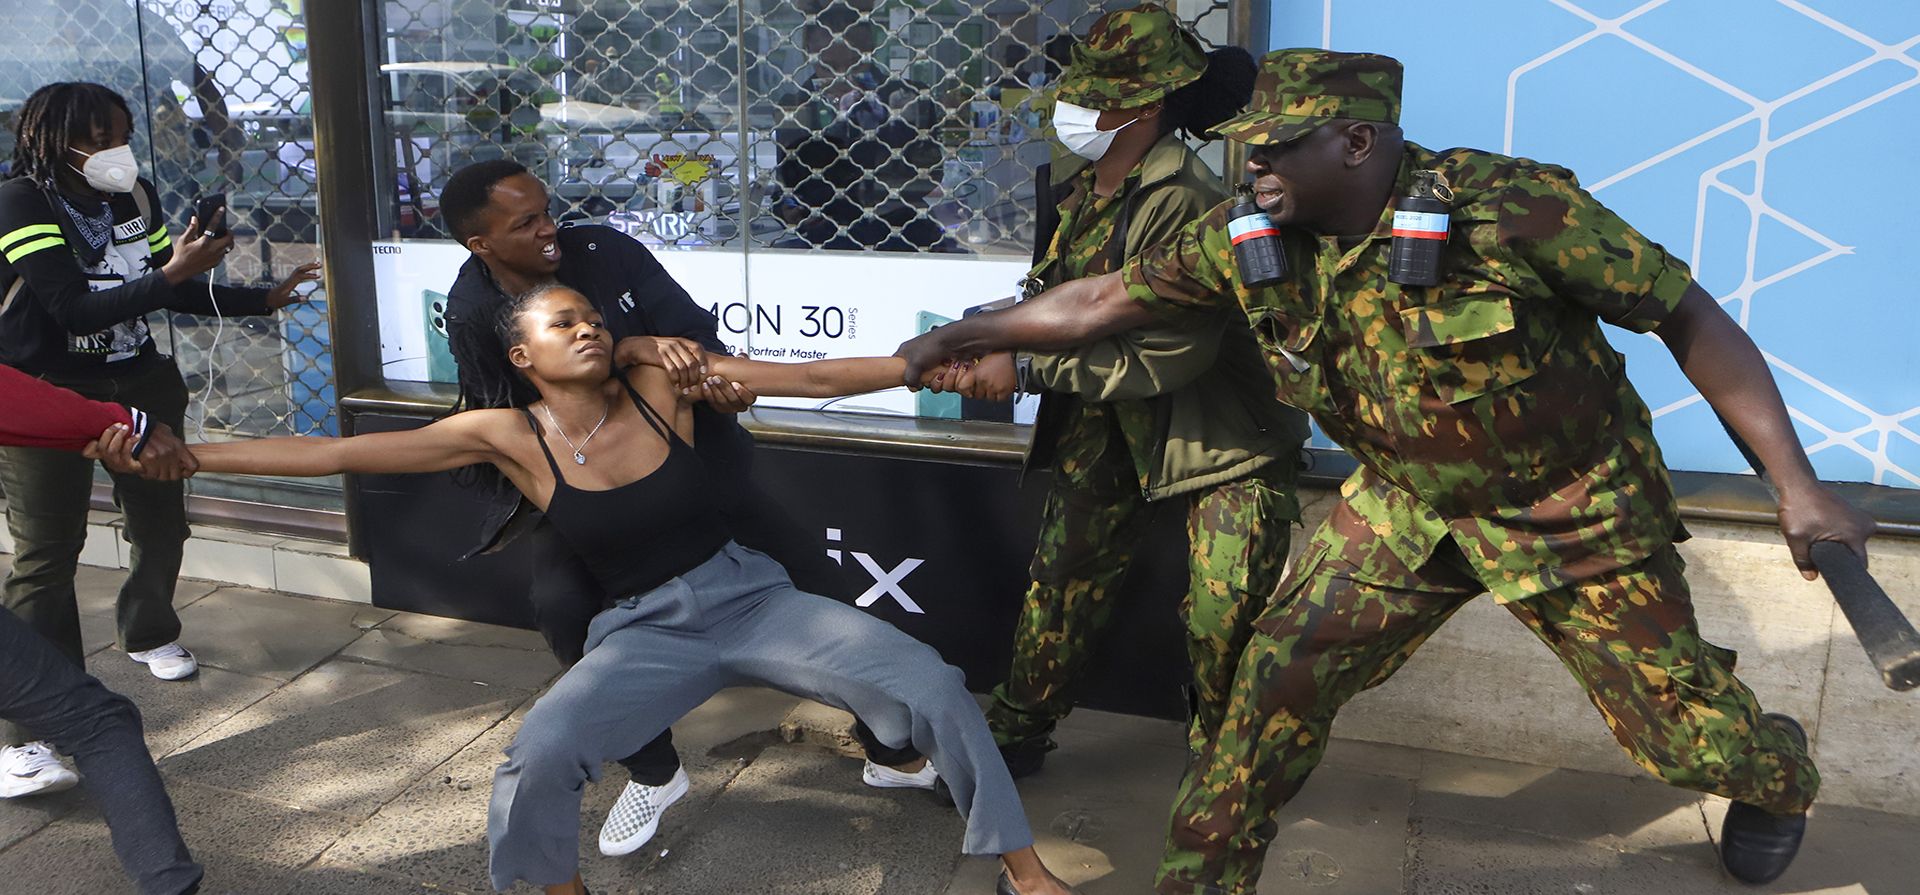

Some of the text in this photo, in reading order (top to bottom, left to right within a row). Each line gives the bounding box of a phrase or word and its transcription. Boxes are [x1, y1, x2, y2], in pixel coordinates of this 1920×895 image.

[608, 210, 695, 236] SPARK
[373, 245, 402, 254] TECNO
[800, 306, 844, 339] 30
[848, 307, 858, 340] Series
[749, 345, 787, 357] Portrait
[790, 348, 828, 360] Master
